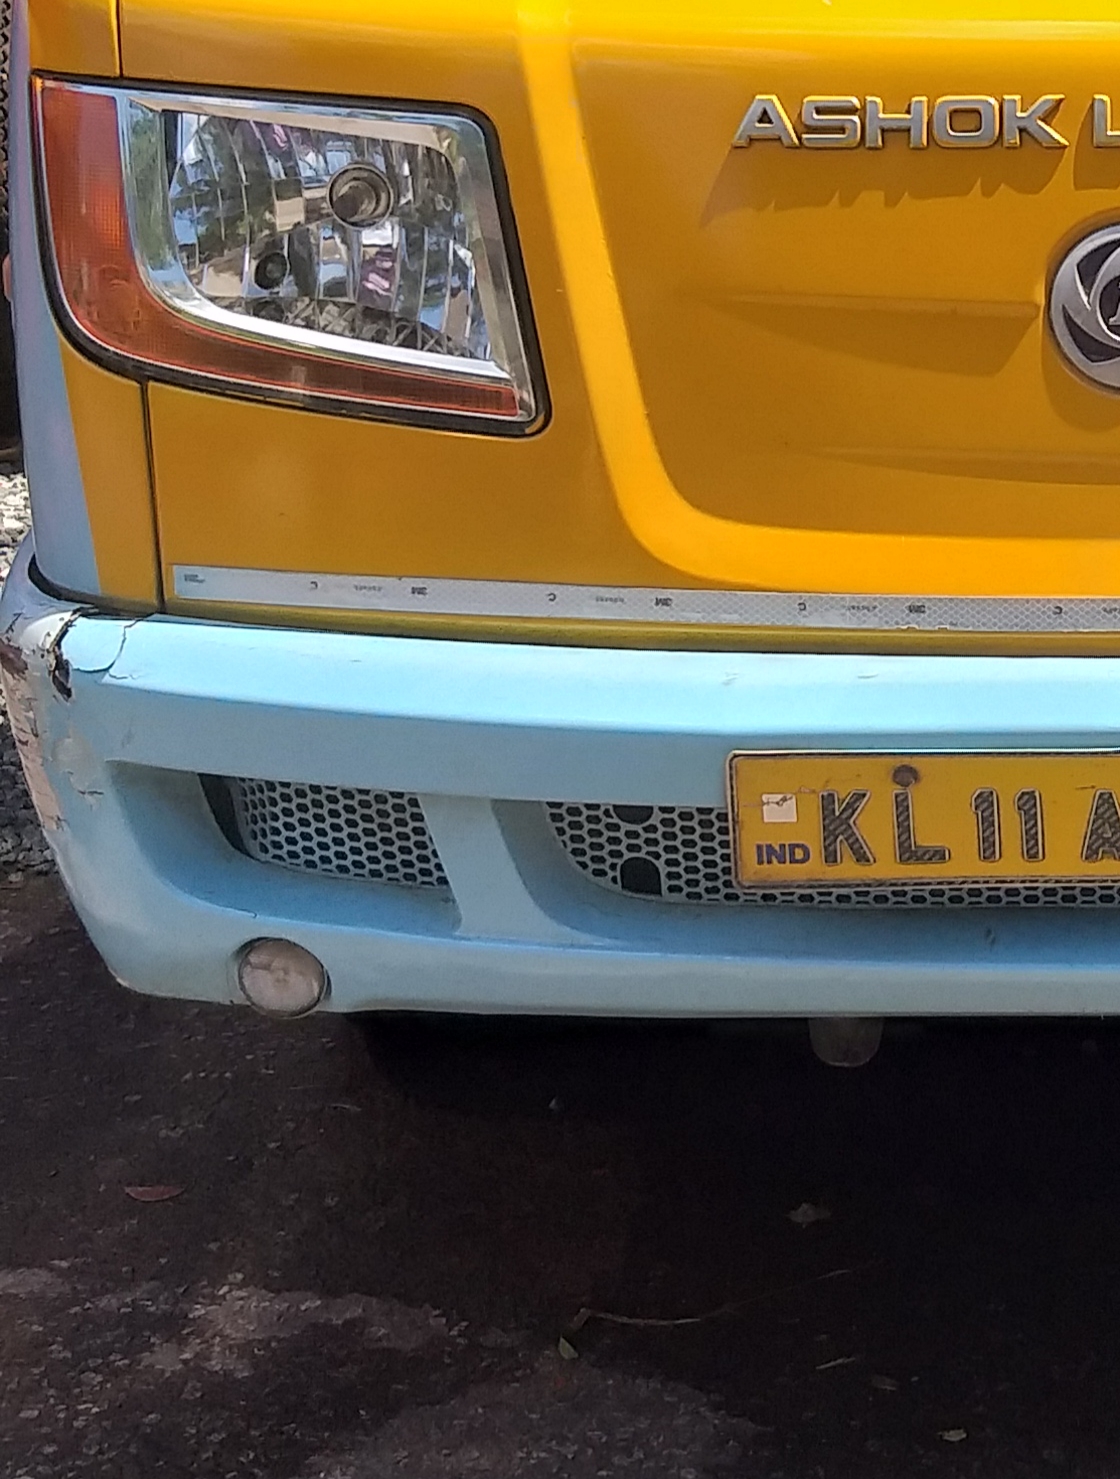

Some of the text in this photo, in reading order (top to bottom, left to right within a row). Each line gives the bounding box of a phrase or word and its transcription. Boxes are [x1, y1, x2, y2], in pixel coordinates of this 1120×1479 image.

[732, 94, 1068, 147] ASHOK
[820, 788, 950, 865] KL
[970, 788, 1043, 862] 11
[755, 844, 811, 866] IND
